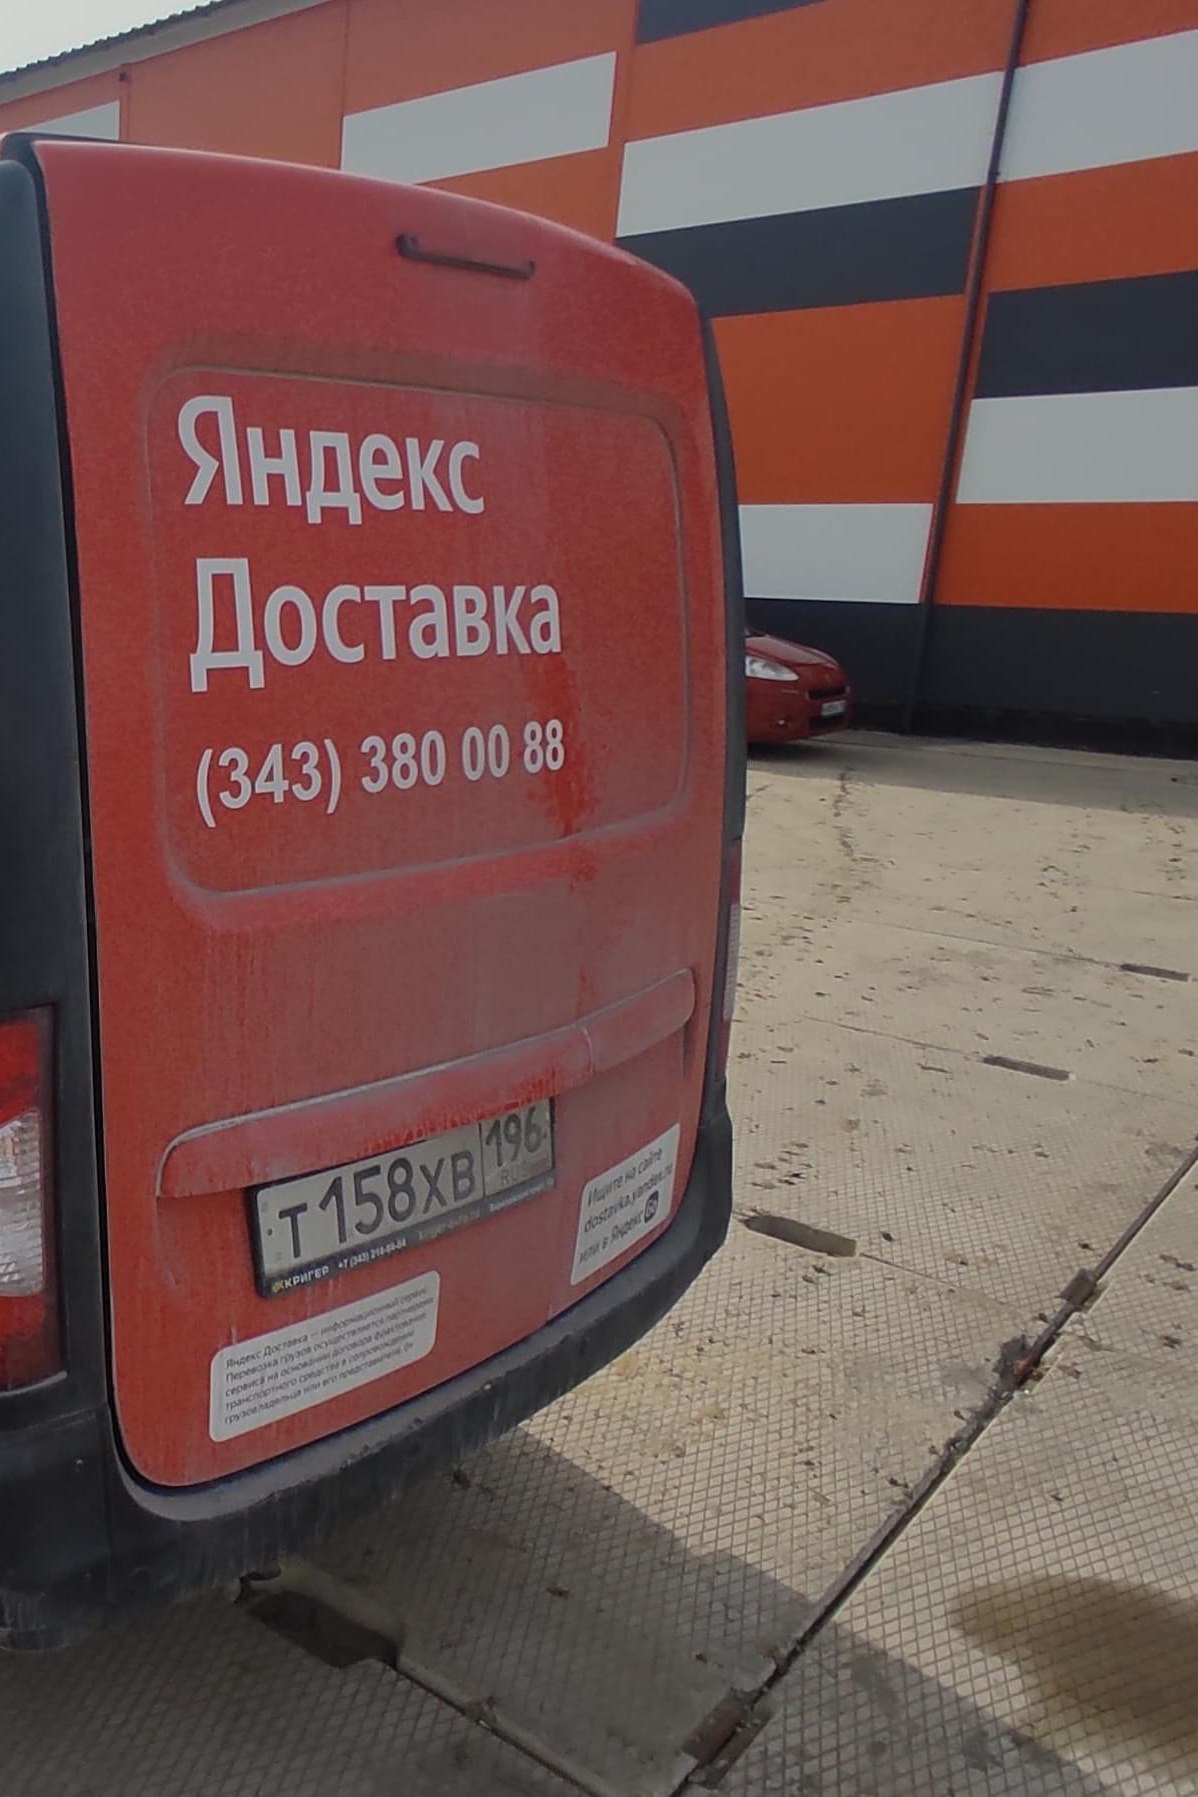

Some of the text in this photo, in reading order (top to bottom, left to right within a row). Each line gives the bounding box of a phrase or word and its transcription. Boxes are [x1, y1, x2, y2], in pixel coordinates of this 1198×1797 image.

[177, 395, 485, 525] Яндекс
[189, 557, 562, 693] Доставка
[196, 719, 565, 828] (343) 380 00 88
[278, 1106, 543, 1259] Т158ХВ 196
[284, 1266, 329, 1289] КРИГЕР
[225, 1354, 278, 1384] Перевозка
[280, 1345, 311, 1366] грузов
[225, 1374, 264, 1399] сервиса
[267, 1369, 278, 1382] на
[226, 1351, 280, 1369] Яндекс
[263, 1333, 327, 1357] Доставка
